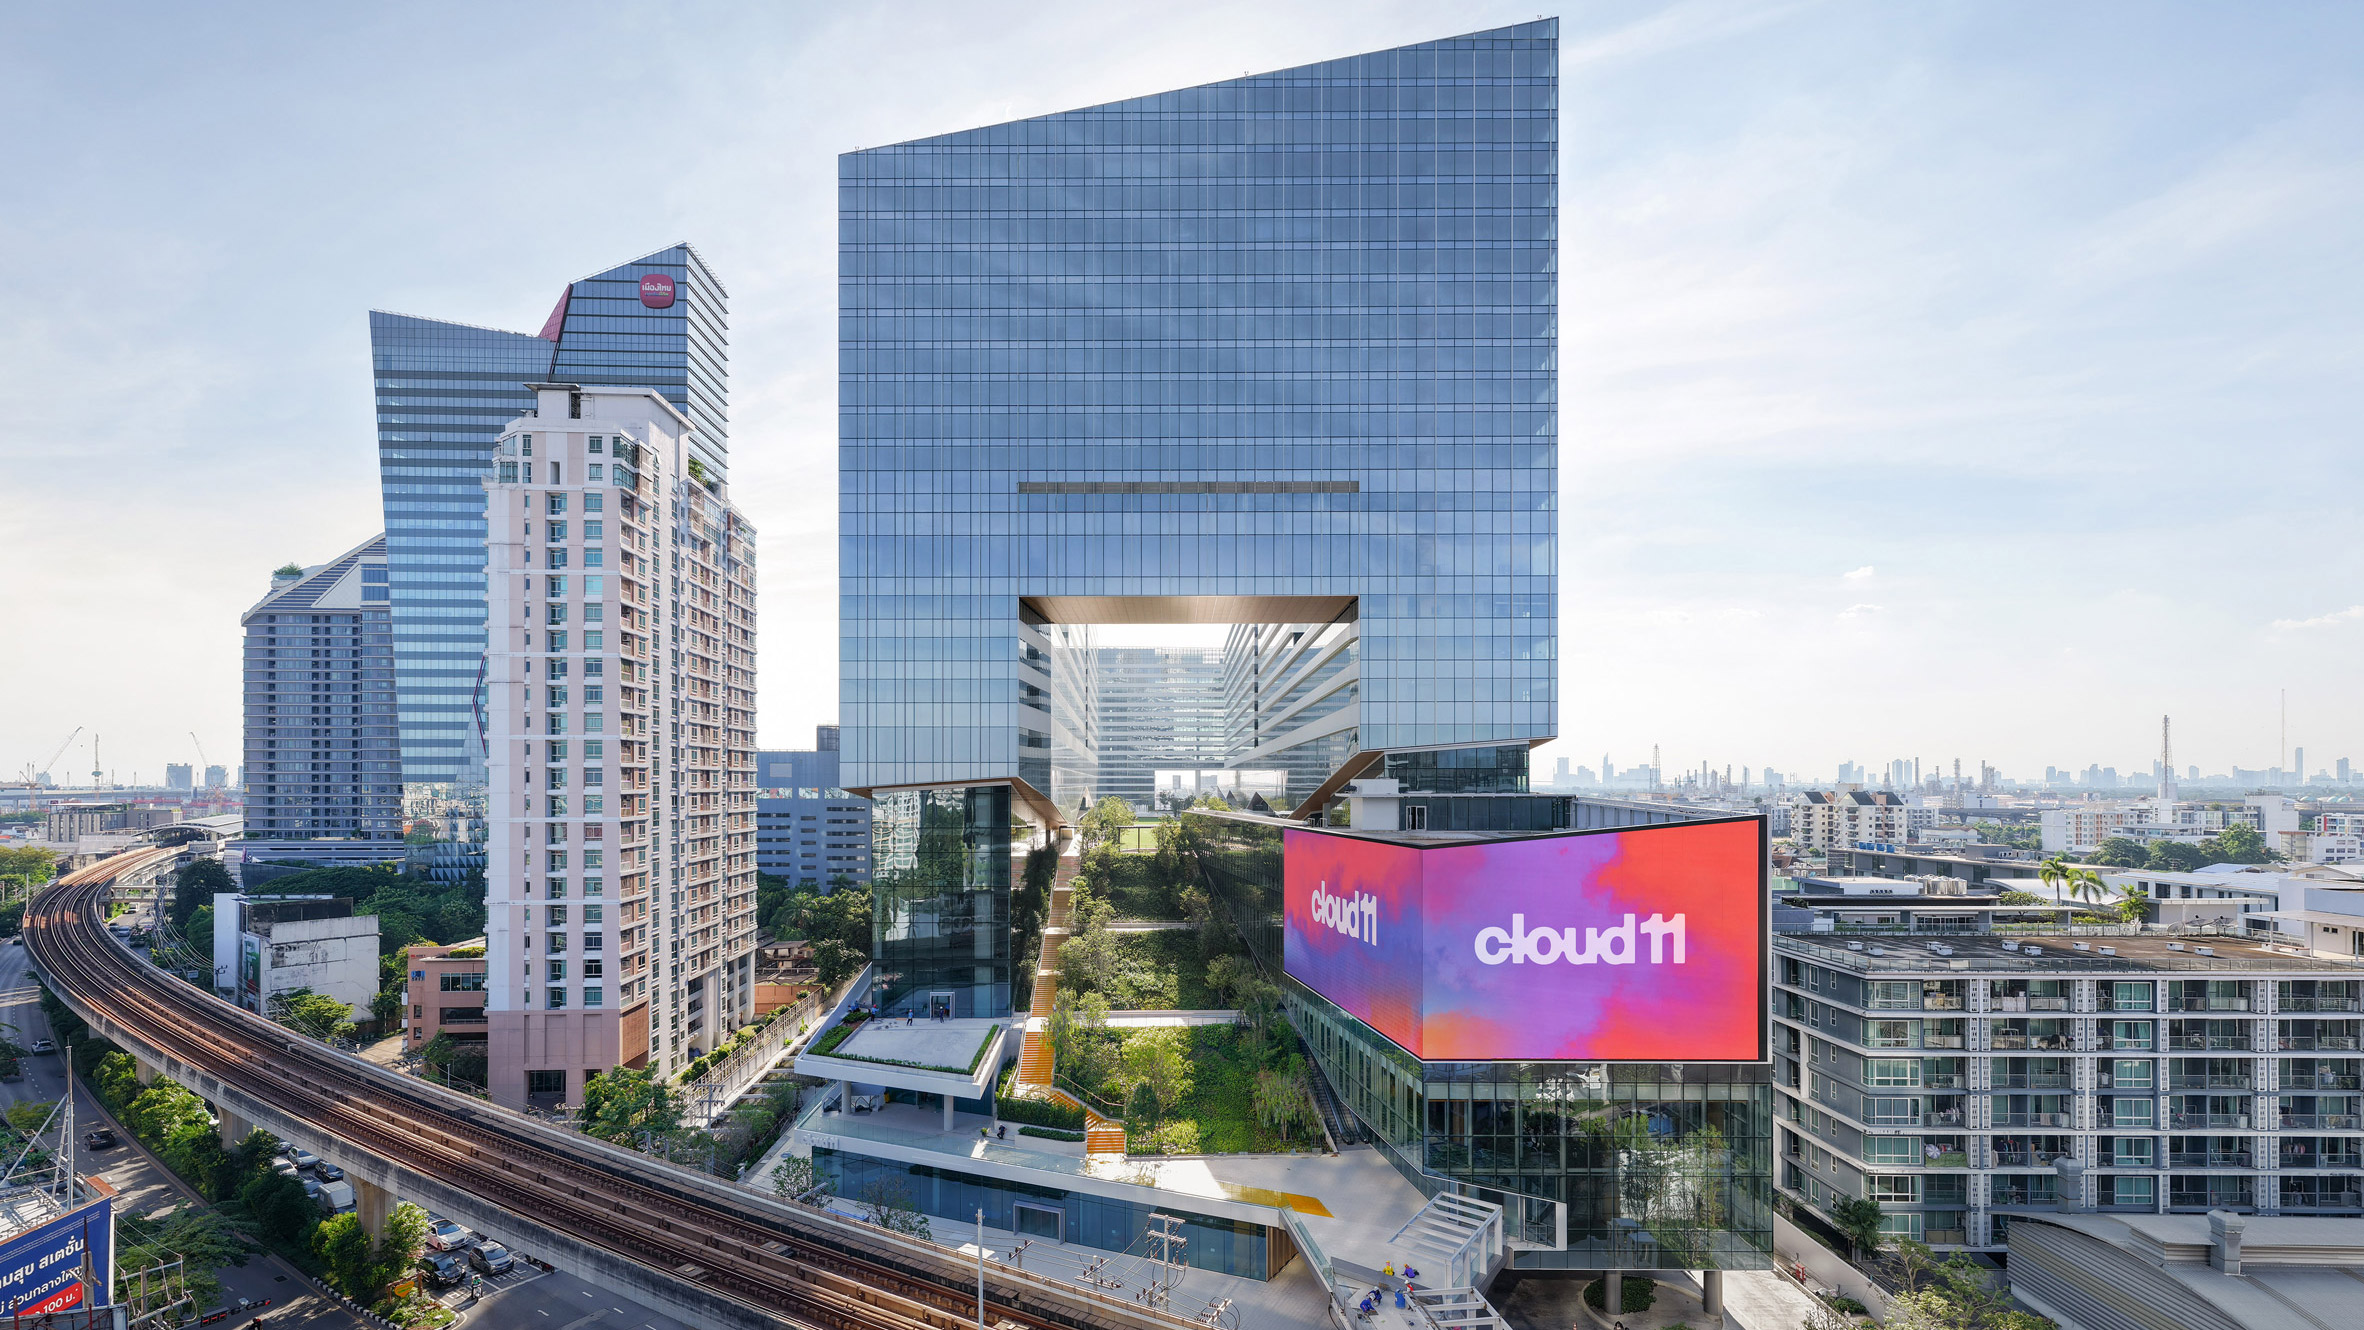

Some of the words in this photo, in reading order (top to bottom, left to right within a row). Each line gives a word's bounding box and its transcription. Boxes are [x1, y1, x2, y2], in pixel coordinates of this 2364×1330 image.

[1311, 880, 1377, 947] cloud11
[1474, 913, 1685, 965] cloud11
[0, 1262, 35, 1288] มสุข
[38, 1235, 84, 1270] สเตชั่น
[43, 1299, 63, 1314] 100
